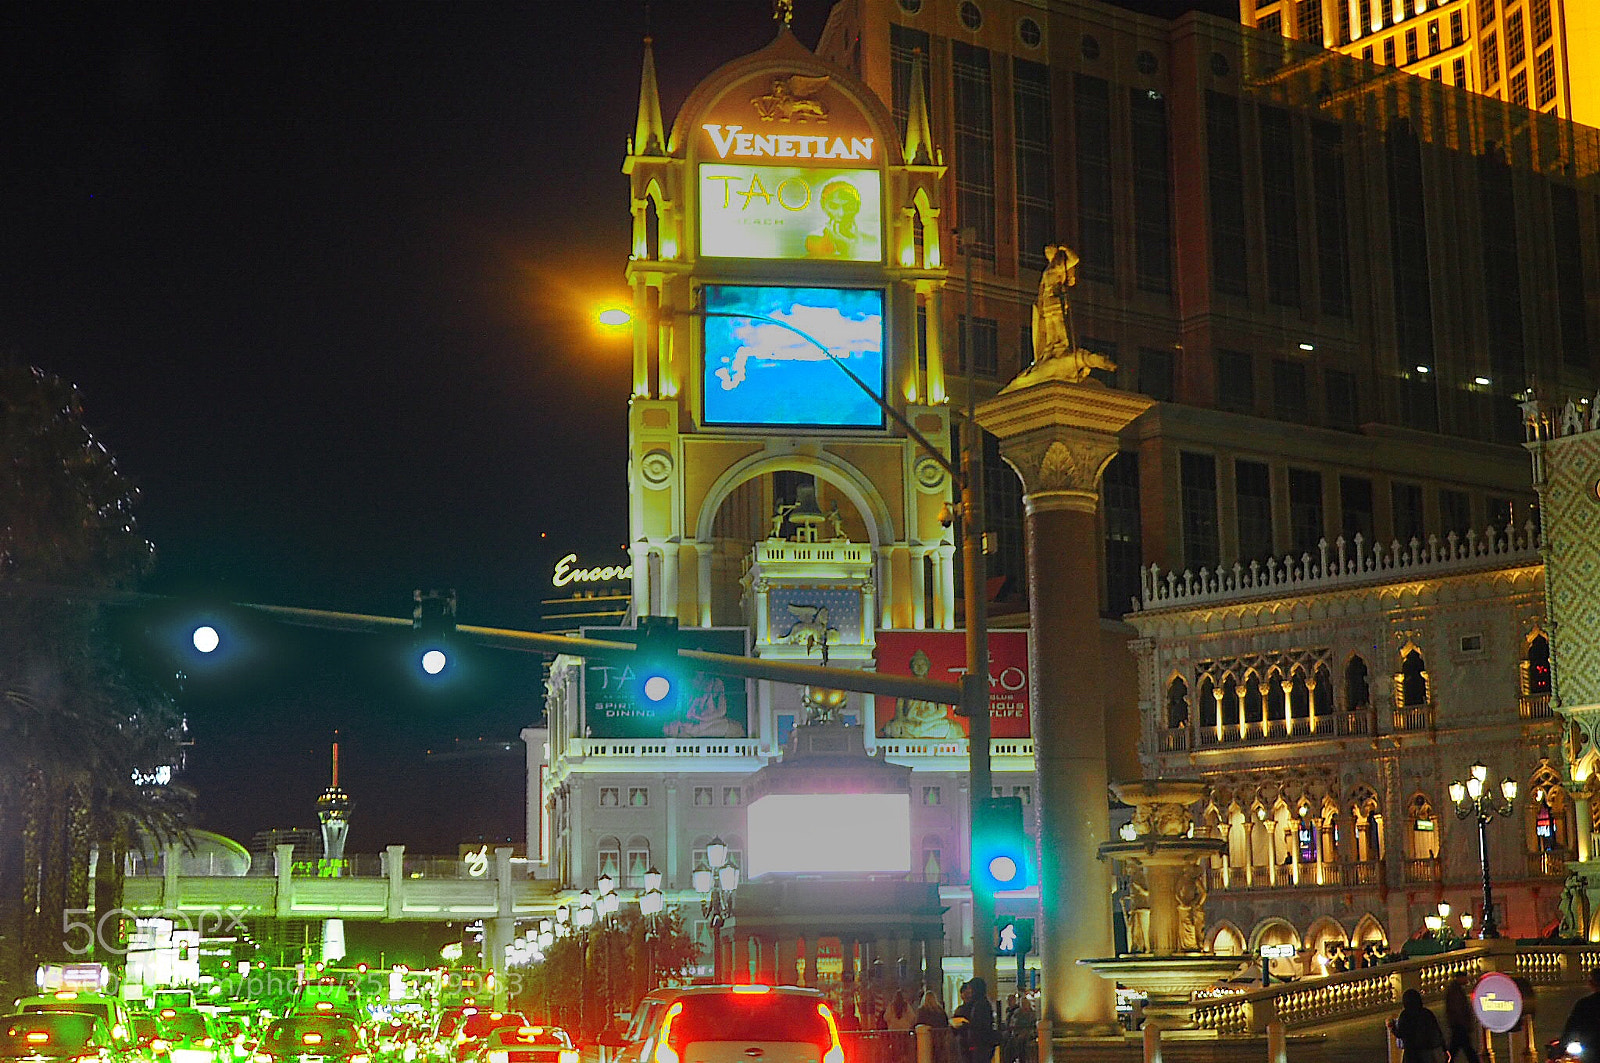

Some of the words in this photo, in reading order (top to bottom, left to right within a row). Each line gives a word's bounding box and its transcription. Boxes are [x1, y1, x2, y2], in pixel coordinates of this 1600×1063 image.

[702, 124, 874, 160] VENETIAN
[706, 172, 811, 212] TAO
[605, 710, 655, 718] DINING
